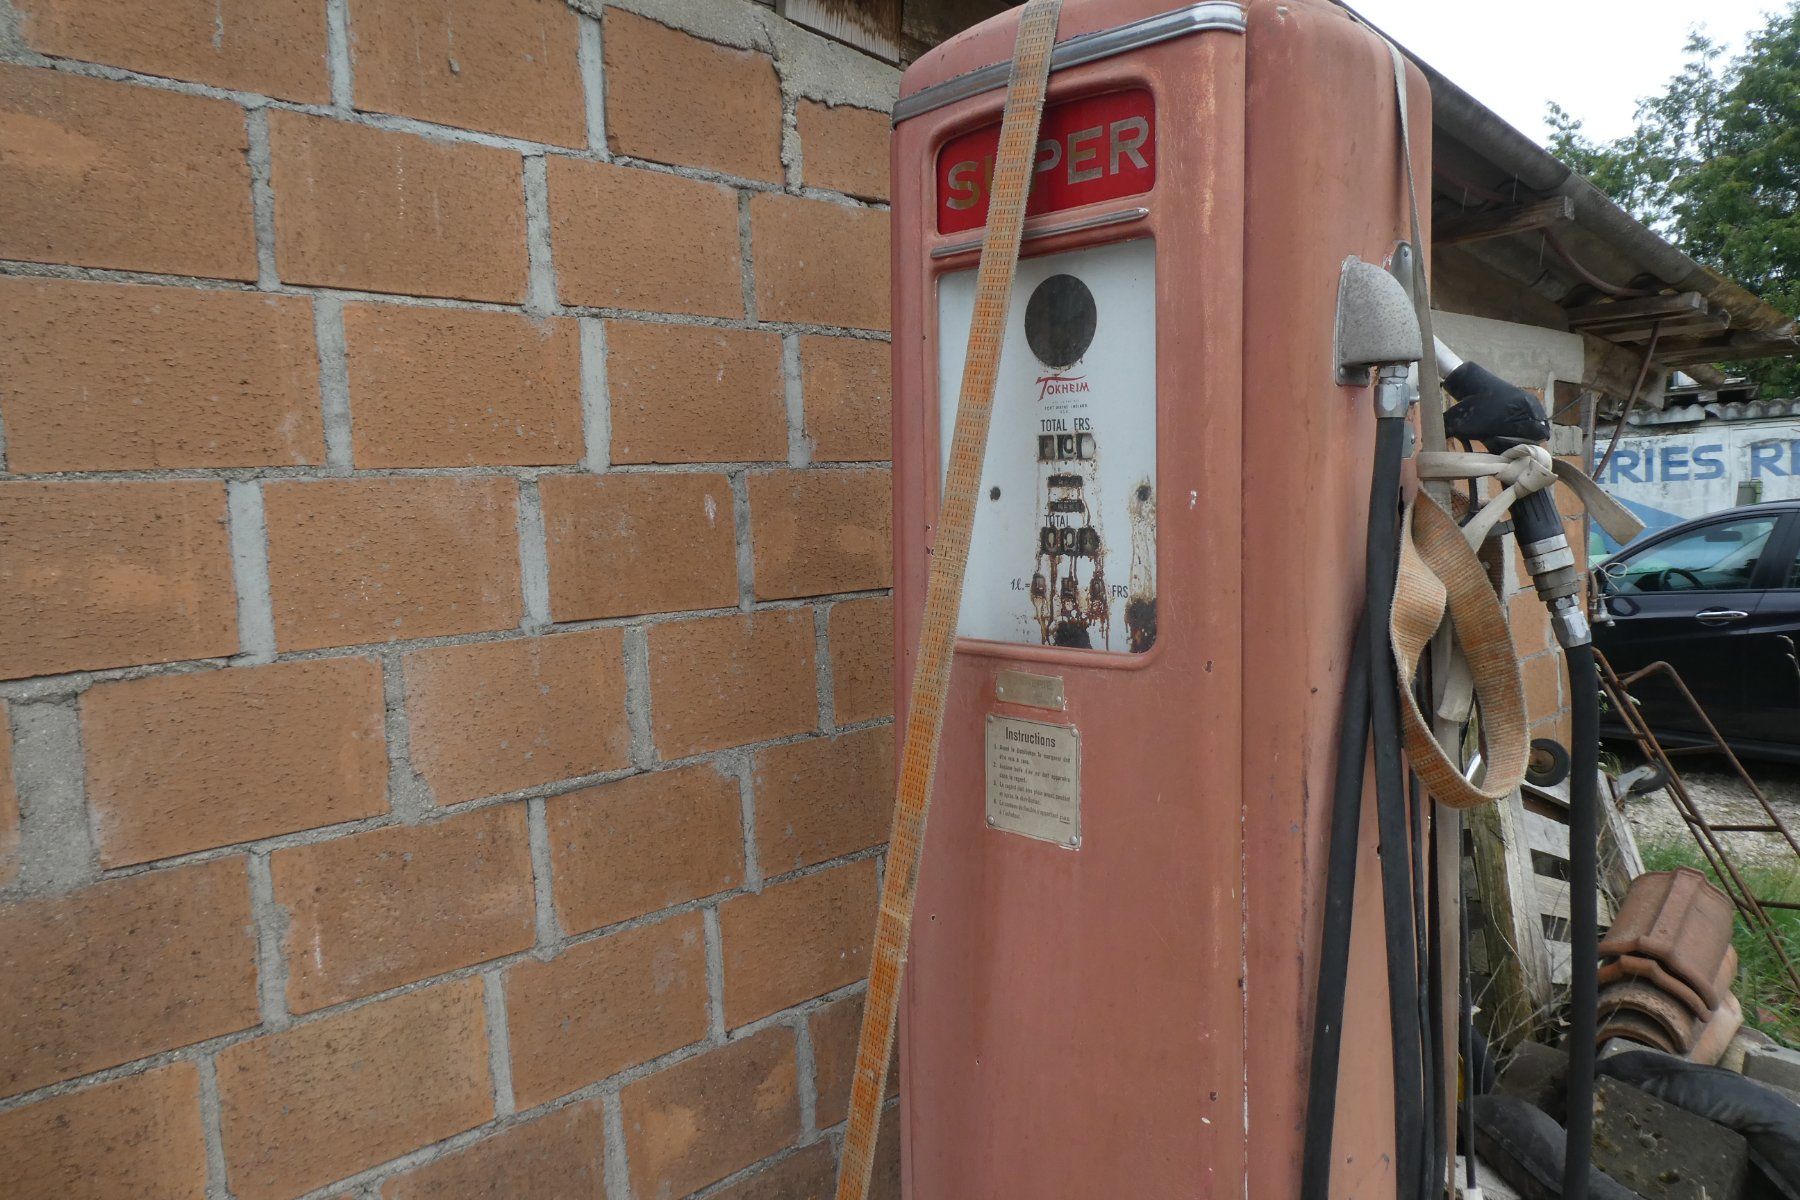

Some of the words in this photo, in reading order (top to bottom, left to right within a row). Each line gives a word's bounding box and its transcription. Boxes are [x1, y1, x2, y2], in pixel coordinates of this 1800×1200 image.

[946, 115, 1150, 210] SPER
[1040, 418, 1067, 432] TOTAL
[1005, 726, 1056, 748] Instructions
